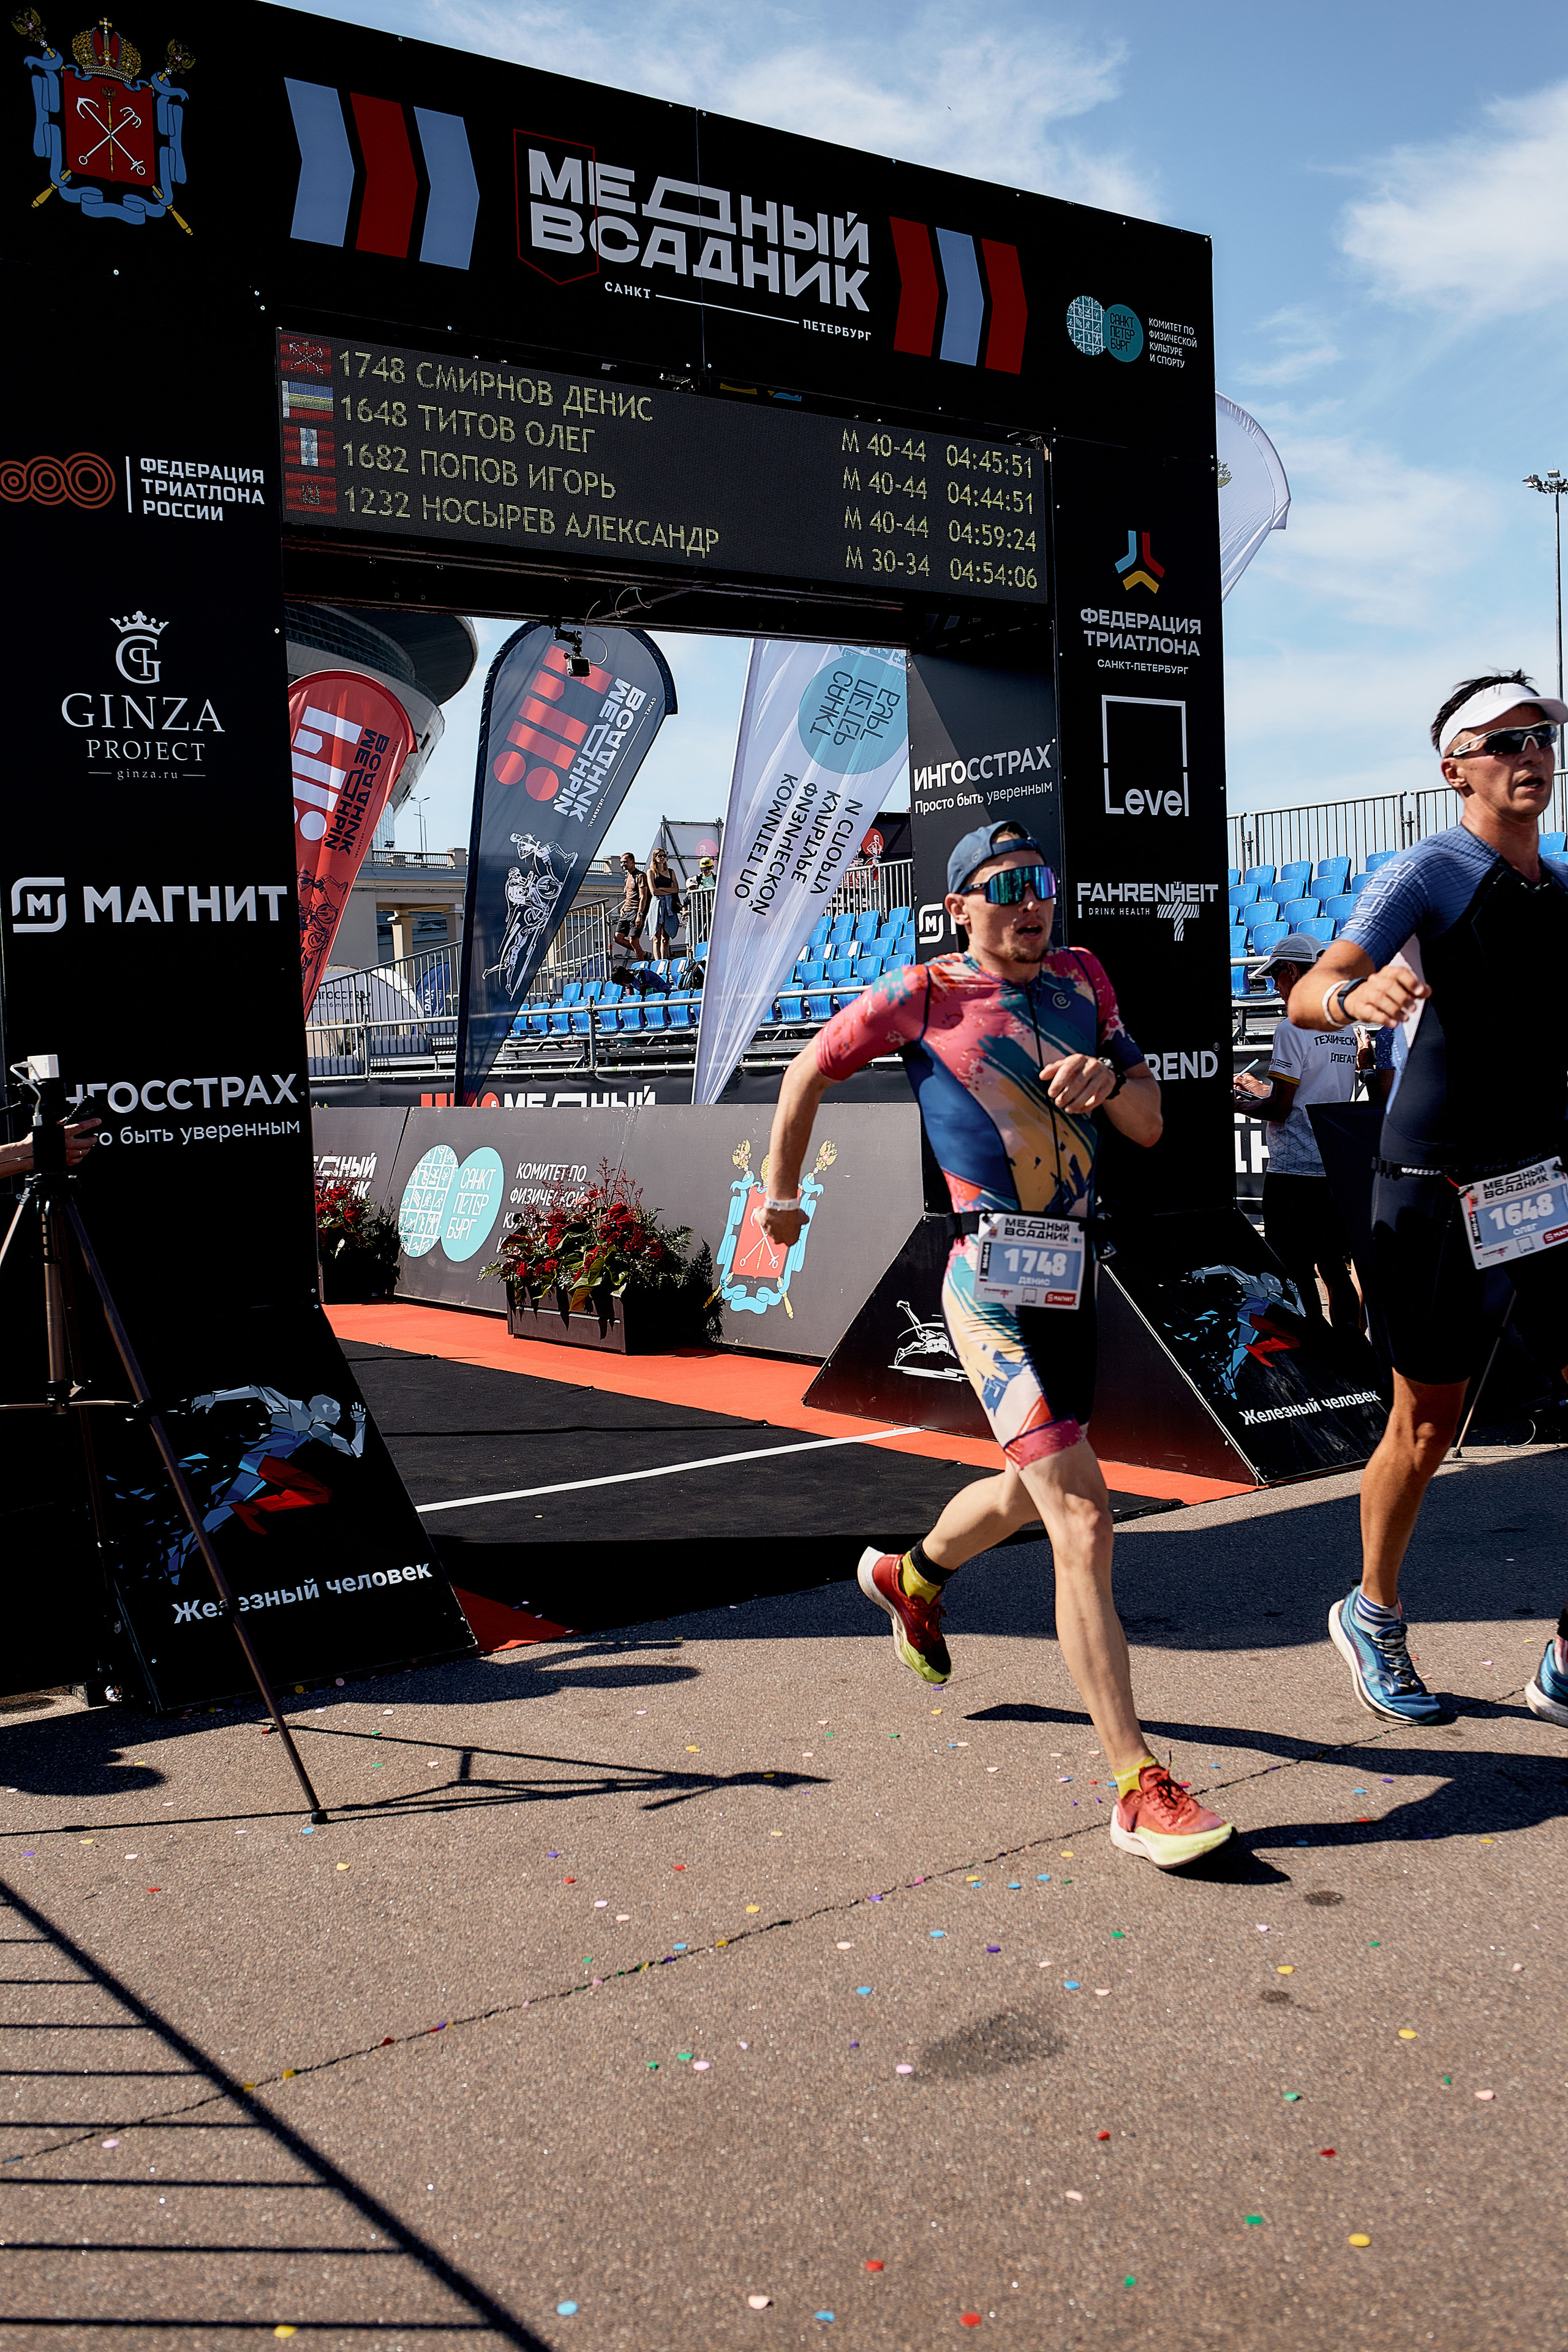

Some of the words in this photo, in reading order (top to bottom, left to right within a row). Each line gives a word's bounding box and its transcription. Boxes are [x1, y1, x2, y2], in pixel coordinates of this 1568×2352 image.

[529, 149, 869, 265] МЕДНЫЙ
[530, 202, 869, 312] ВСАДНИК
[605, 281, 651, 299] САНКТ
[803, 319, 872, 341] ПЕТЕРБУРГ
[1110, 313, 1134, 329] САНКТ
[1110, 325, 1135, 341] ПЕТЕР
[1148, 317, 1182, 333] КОМИТЕТ
[1183, 325, 1194, 336] ПО
[1148, 330, 1197, 348] ФИЗИЧЕСКОЙ
[1110, 337, 1131, 352] БУРГ
[1149, 341, 1183, 356] КУЛЬТУРЕ
[1150, 353, 1155, 363] И
[1156, 355, 1185, 368] СПОРТУ
[339, 350, 405, 383] 1748
[416, 361, 553, 407] СМИРНОВ
[563, 385, 654, 421] ДЕНИС
[842, 428, 859, 453] М
[867, 434, 927, 462] 40-44
[946, 445, 1032, 478] 04:45:51
[341, 394, 408, 427] 1648
[418, 404, 515, 443] ТИТОВ
[525, 420, 595, 453] ОЛЕГ
[843, 467, 861, 491] М
[868, 472, 927, 500] 40-44
[947, 482, 1033, 515] 04:44:51
[140, 458, 264, 484] ФЕДЕРАЦИЯ
[141, 478, 265, 505] ТРИАТЛОНА
[343, 441, 409, 473] 1682
[421, 450, 518, 486] ПОПОВ
[529, 465, 616, 499] ИГОРЬ
[845, 507, 862, 531] М
[870, 511, 929, 538] 40-44
[949, 520, 1036, 552] 04:59:24
[143, 500, 224, 521] РОССИИ
[344, 486, 410, 518] 1232
[423, 496, 555, 535] НОСЫРЕВ
[565, 513, 719, 558] АЛЕКСАНДР
[846, 546, 864, 570] М
[872, 549, 930, 577] 30-34
[950, 558, 1038, 590] 04:54:06
[1080, 608, 1202, 635] ФЕДЕРАЦИЯ
[1084, 630, 1200, 656] ТРИАТЛОНА
[1097, 659, 1188, 675] САНКТ-ПЕТЕРБУРГ
[61, 693, 225, 732] GINZA
[87, 739, 205, 761] PROJECT
[117, 769, 178, 780] ginza.ru
[913, 744, 1052, 791] ИНГОССТРАХ
[914, 797, 955, 816] Просто
[956, 792, 984, 809] быть
[986, 780, 1054, 805] уверенным
[1104, 768, 1189, 816] Level
[83, 886, 287, 923] МАГНИТ
[1077, 882, 1219, 902] FAHRENHEIT
[1144, 1050, 1218, 1080] REND
[120, 1126, 173, 1144] быть
[182, 1120, 300, 1145] уверенным
[313, 1152, 377, 1178] ДНЫЙ
[516, 1163, 569, 1181] КОМИТЕТ
[1483, 1164, 1547, 1191] МЕДНЫЙ
[460, 1167, 497, 1191] САНКТ
[1484, 1174, 1548, 1199] ВСАДНИК
[453, 1192, 489, 1216] ПЕТЕР
[1489, 1193, 1555, 1230] 1648
[446, 1217, 477, 1241] БУРГ
[1004, 1227, 1069, 1242] ВСАДНИК
[1005, 1218, 1069, 1232] МЕДНЫЙ
[1003, 1248, 1068, 1276] 1748
[1238, 1398, 1322, 1425] Железный
[1321, 1390, 1382, 1410] человек
[172, 1578, 319, 1624] Жеезный
[326, 1562, 432, 1595] человек
